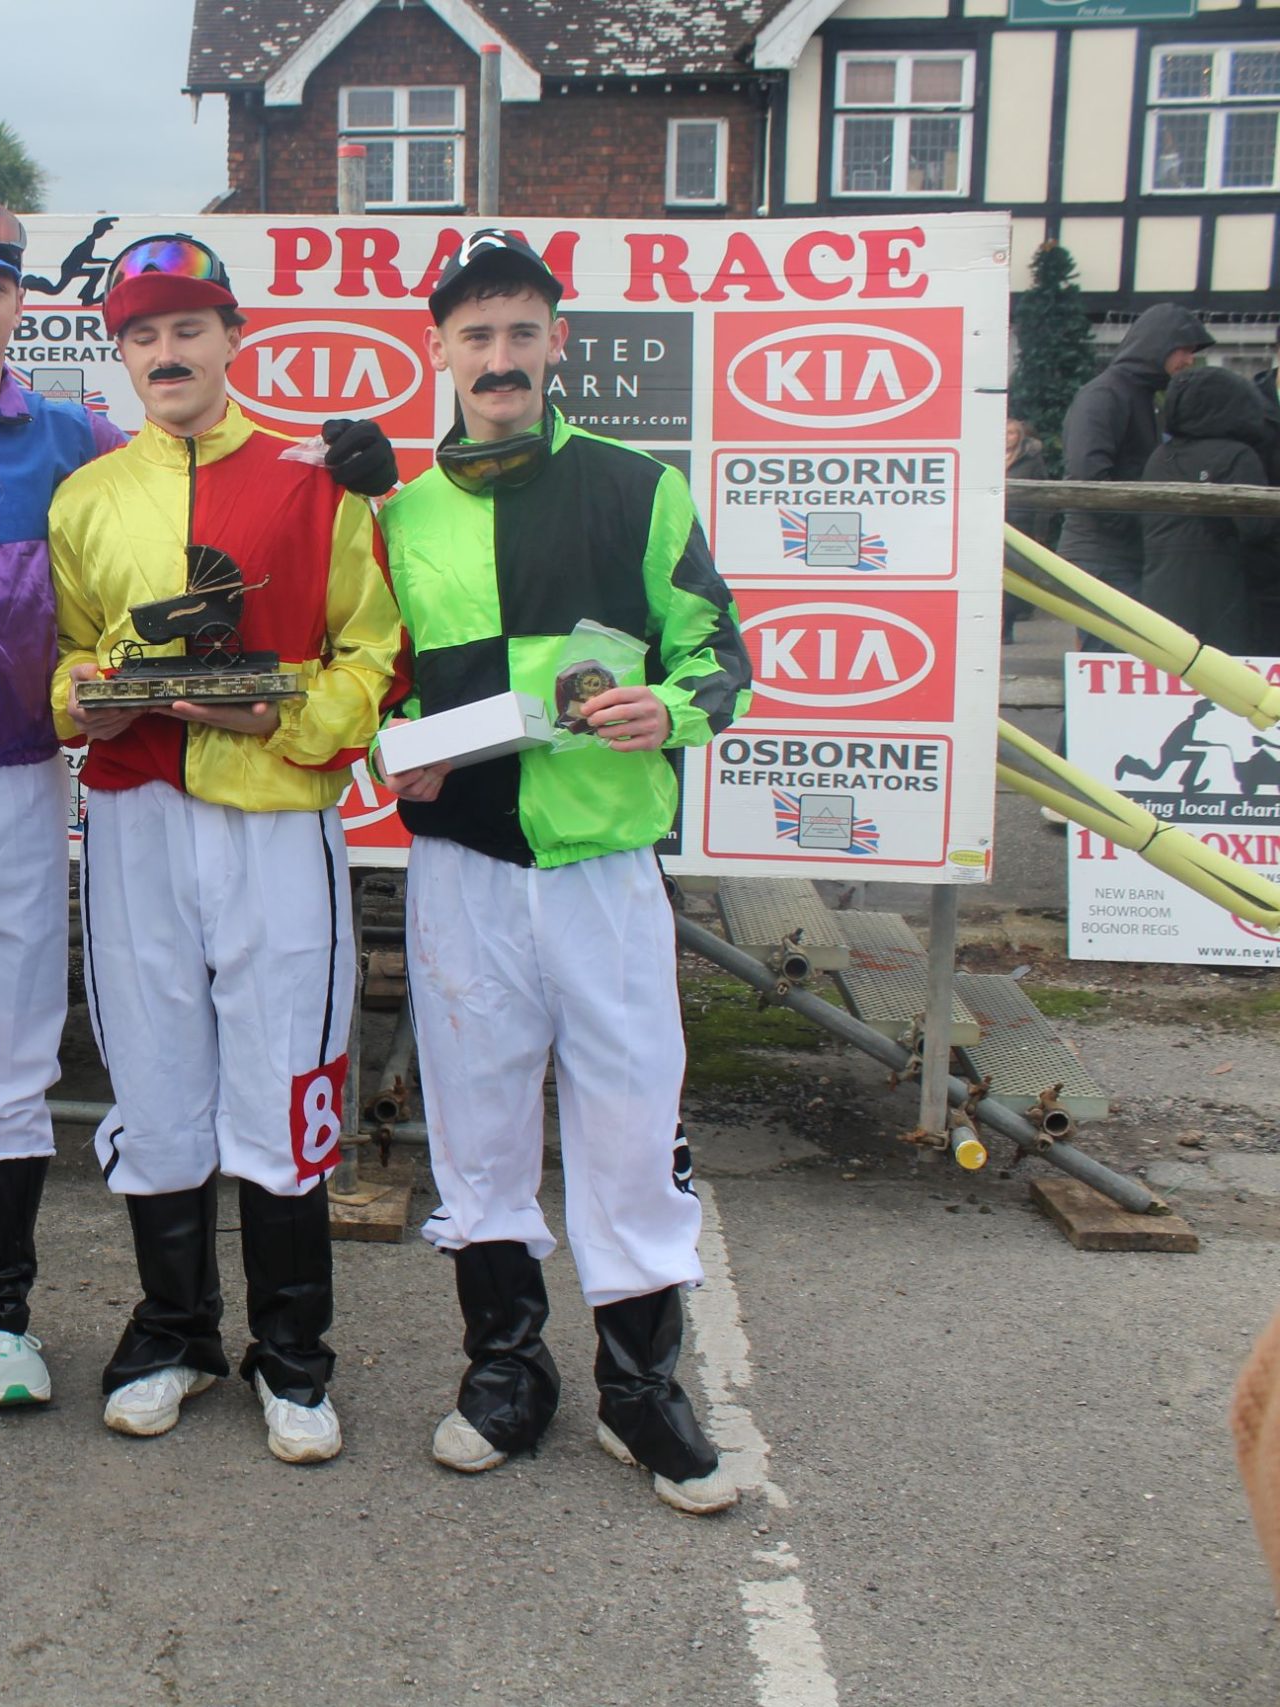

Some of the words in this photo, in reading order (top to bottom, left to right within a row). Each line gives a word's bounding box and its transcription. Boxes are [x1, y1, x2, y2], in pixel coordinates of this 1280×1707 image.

[623, 226, 929, 302] RACE
[255, 346, 391, 398] KIA
[764, 349, 907, 402] KIA
[547, 374, 638, 398] ARN
[567, 414, 688, 425] arncars.com
[724, 458, 946, 485] OSBORNE
[725, 489, 946, 506] REFRIGERATORS
[759, 627, 901, 681] KIA
[720, 738, 939, 771] OSBORNE
[720, 769, 939, 792] REFRIGERATORS
[1180, 799, 1225, 816] local
[1231, 801, 1280, 818] chari
[1095, 888, 1125, 899] NEW
[1129, 889, 1164, 900] BARN
[1089, 905, 1171, 918] SHOWROOM
[1081, 922, 1139, 935] BOGNOR
[1142, 924, 1179, 936] REGIS
[1198, 946, 1280, 959] www.newb
[302, 1076, 340, 1163] 8
